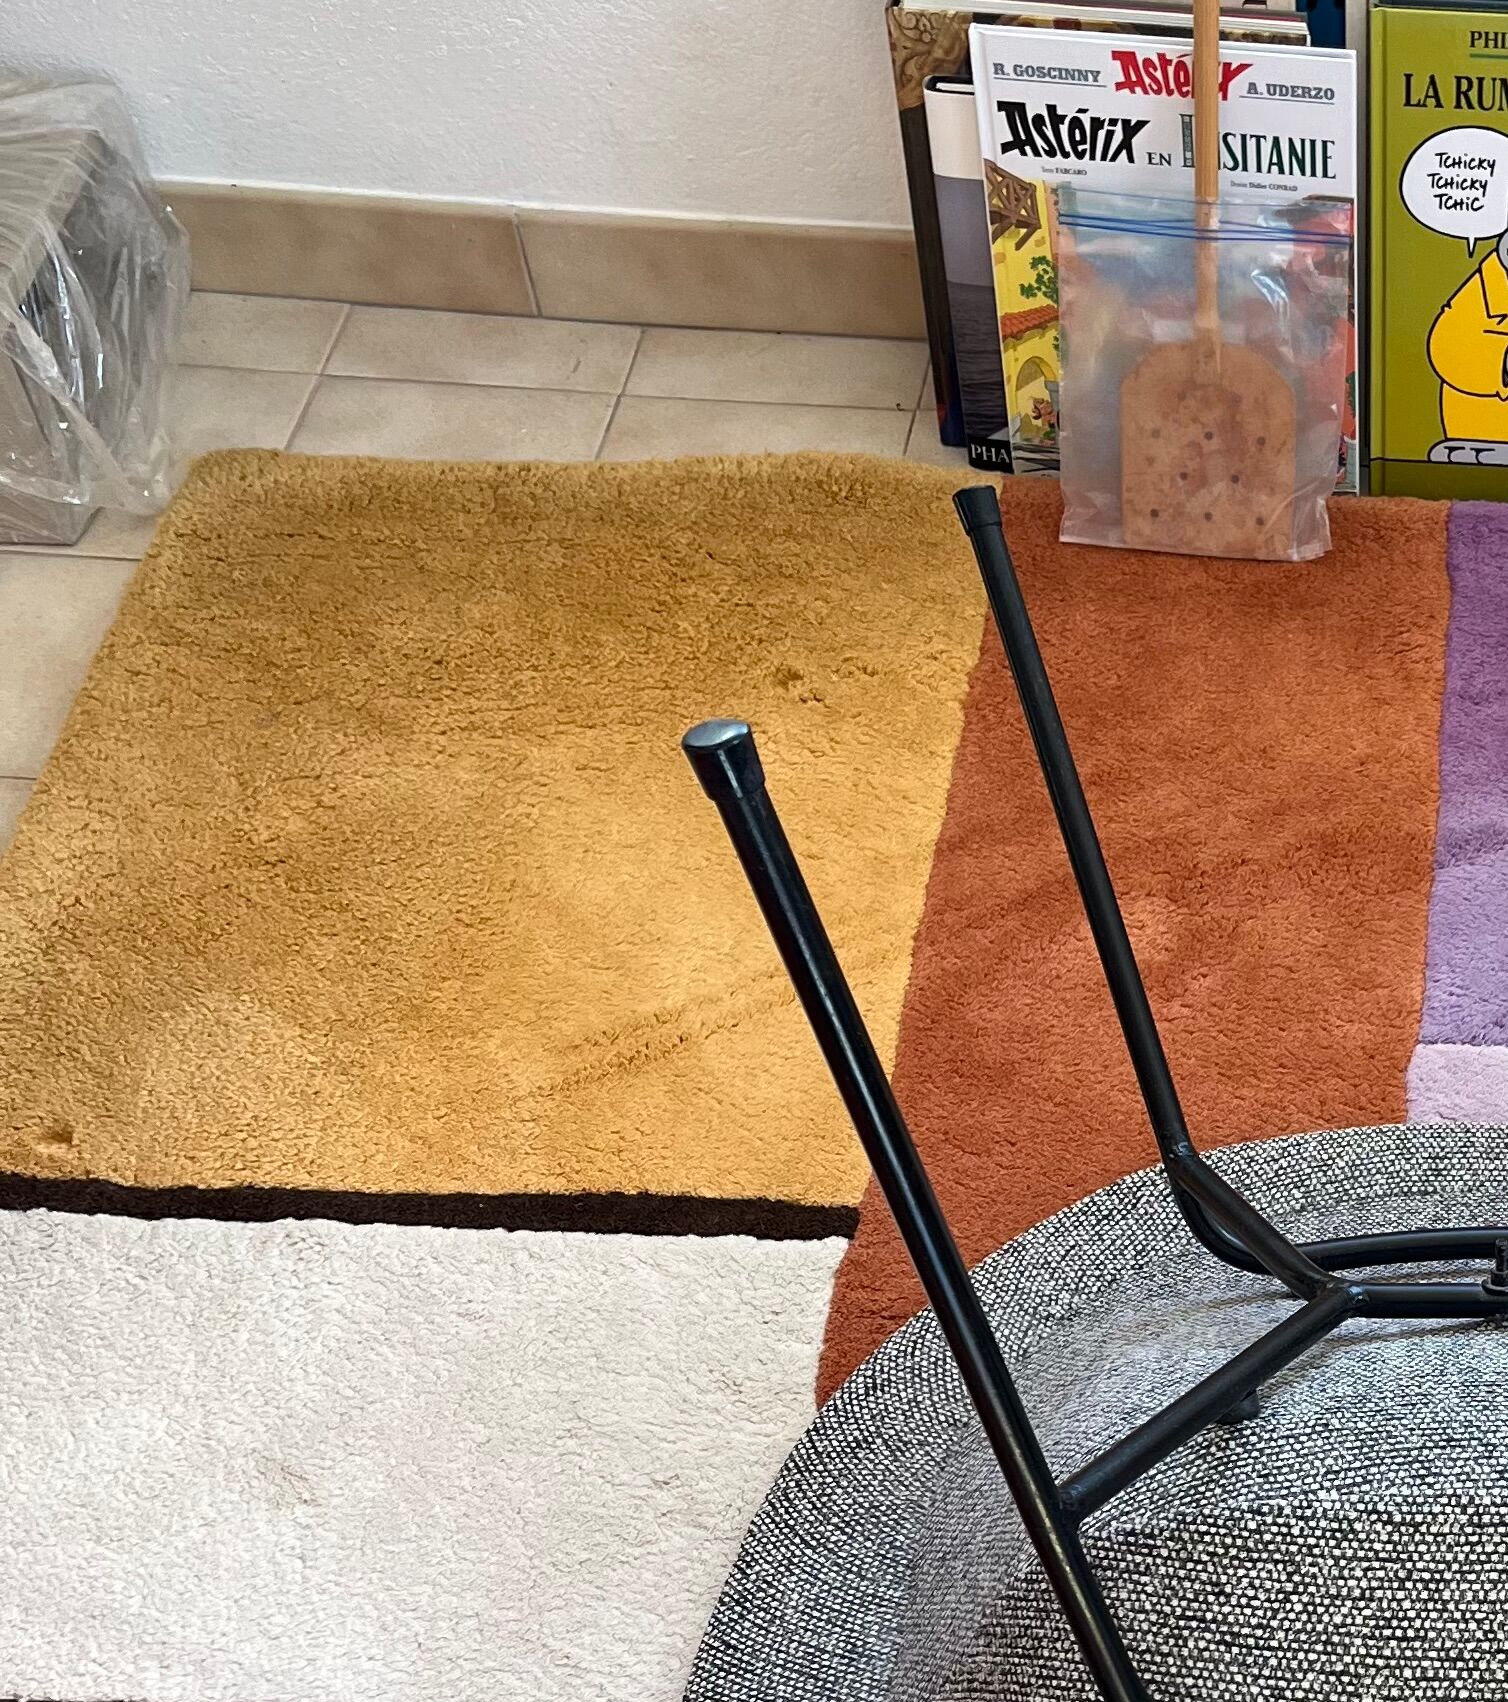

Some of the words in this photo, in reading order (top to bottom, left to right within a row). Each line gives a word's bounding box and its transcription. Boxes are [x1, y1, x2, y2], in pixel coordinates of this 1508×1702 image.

[992, 62, 1011, 77] R.
[1012, 63, 1102, 84] GOSCINNY
[1111, 50, 1254, 101] Astéx
[1246, 81, 1264, 96] A.
[1265, 82, 1336, 101] UDERZO
[1402, 72, 1445, 110] LA
[996, 99, 1152, 165] Astérix
[1145, 151, 1172, 167] EN
[1179, 112, 1337, 180] LSITANIE
[970, 442, 1011, 464] PHA
